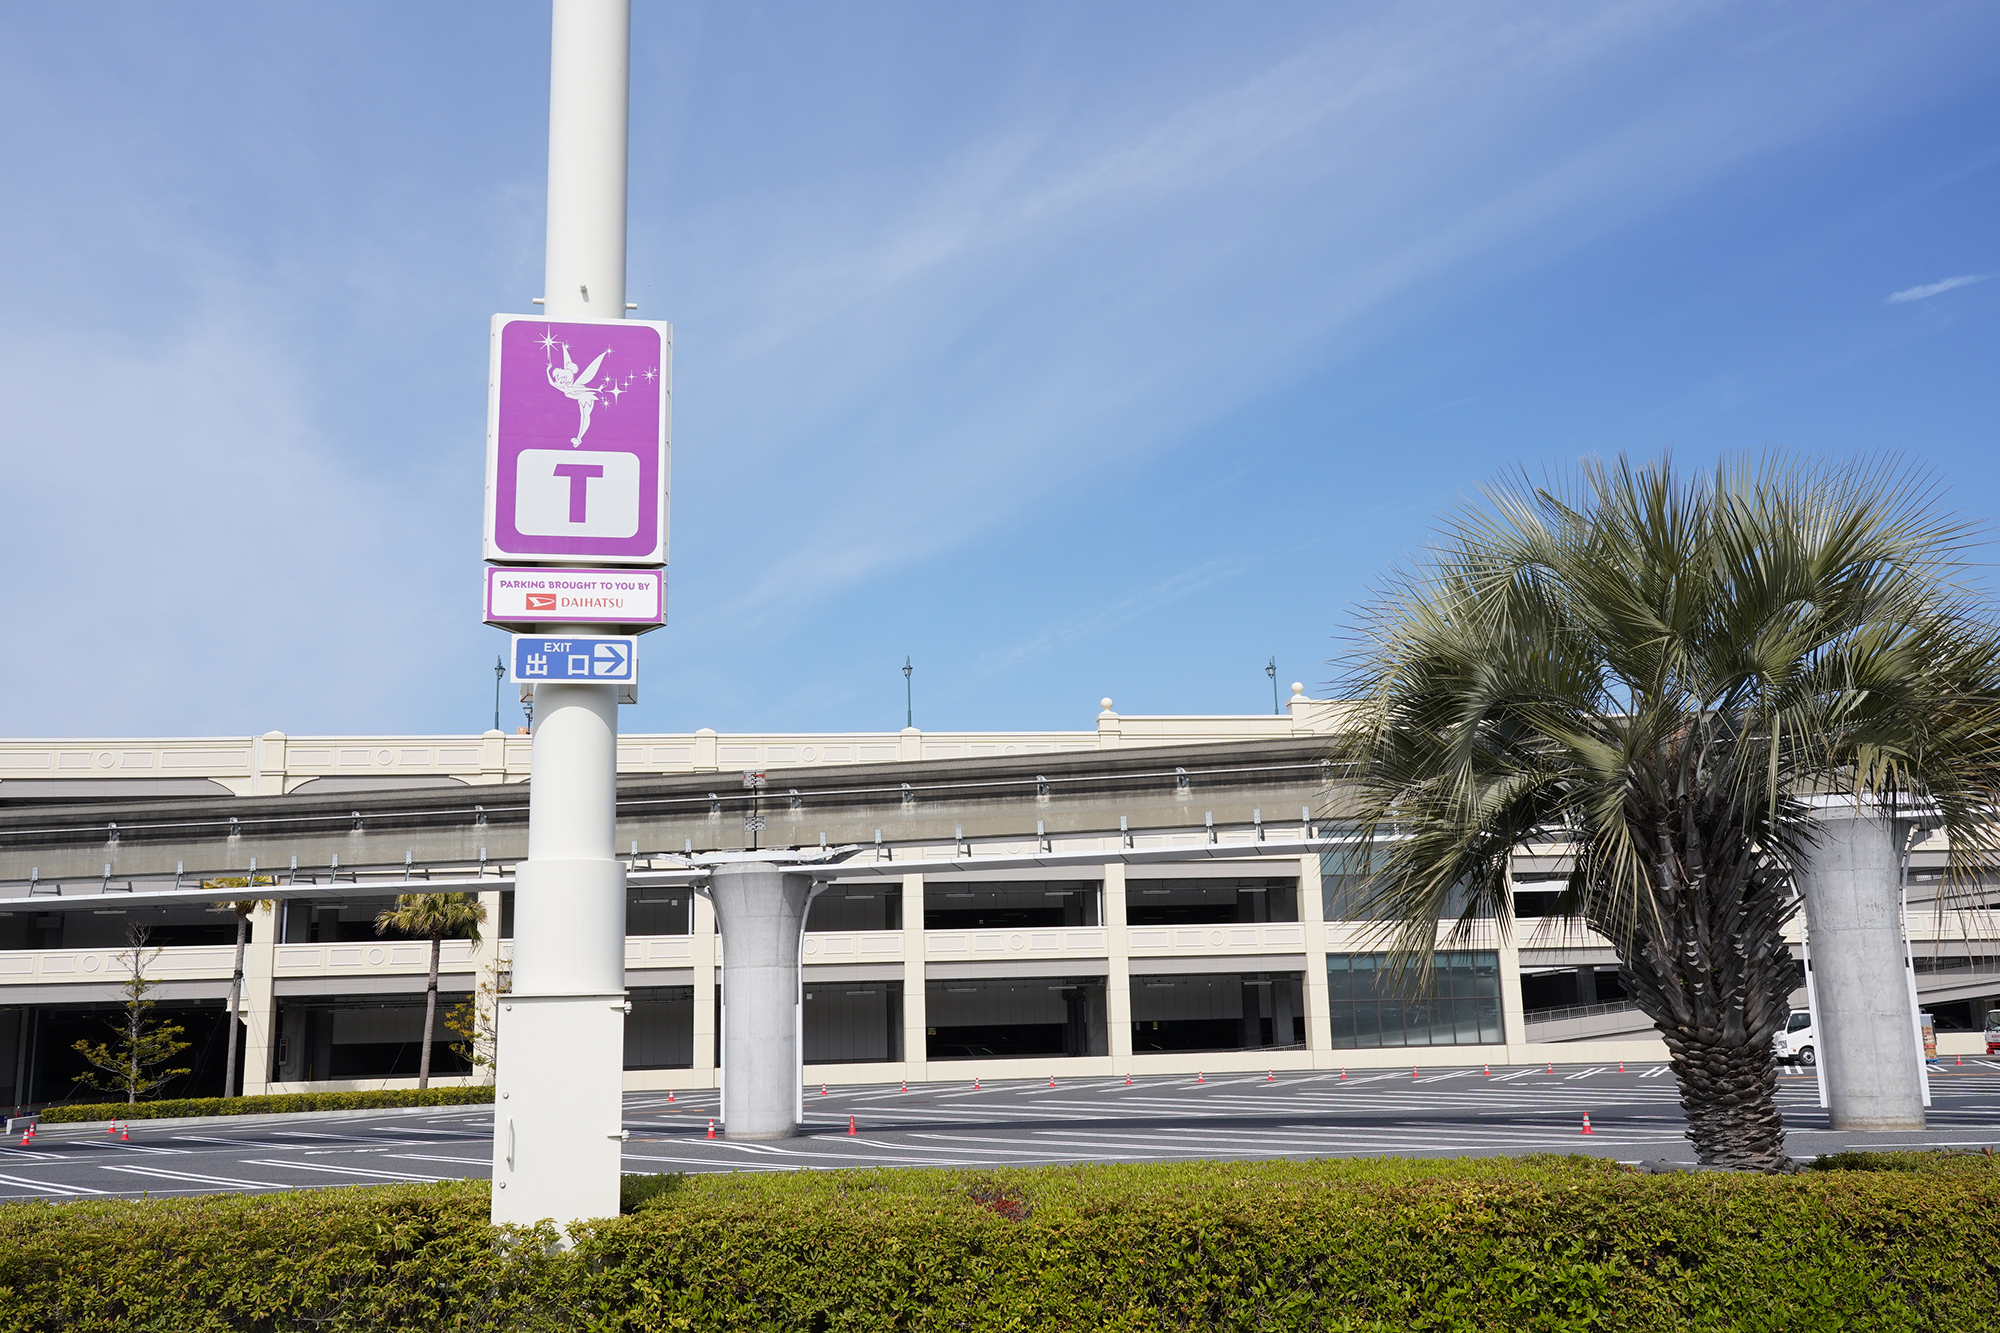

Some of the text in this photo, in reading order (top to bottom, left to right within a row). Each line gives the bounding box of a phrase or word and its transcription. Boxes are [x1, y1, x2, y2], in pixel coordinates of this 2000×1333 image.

[553, 463, 603, 523] T
[500, 580, 650, 590] PARKING BROUGHT TO YOU BY
[561, 597, 624, 608] DAIHATSU
[544, 642, 572, 652] EXIT
[525, 653, 590, 676] 出口
